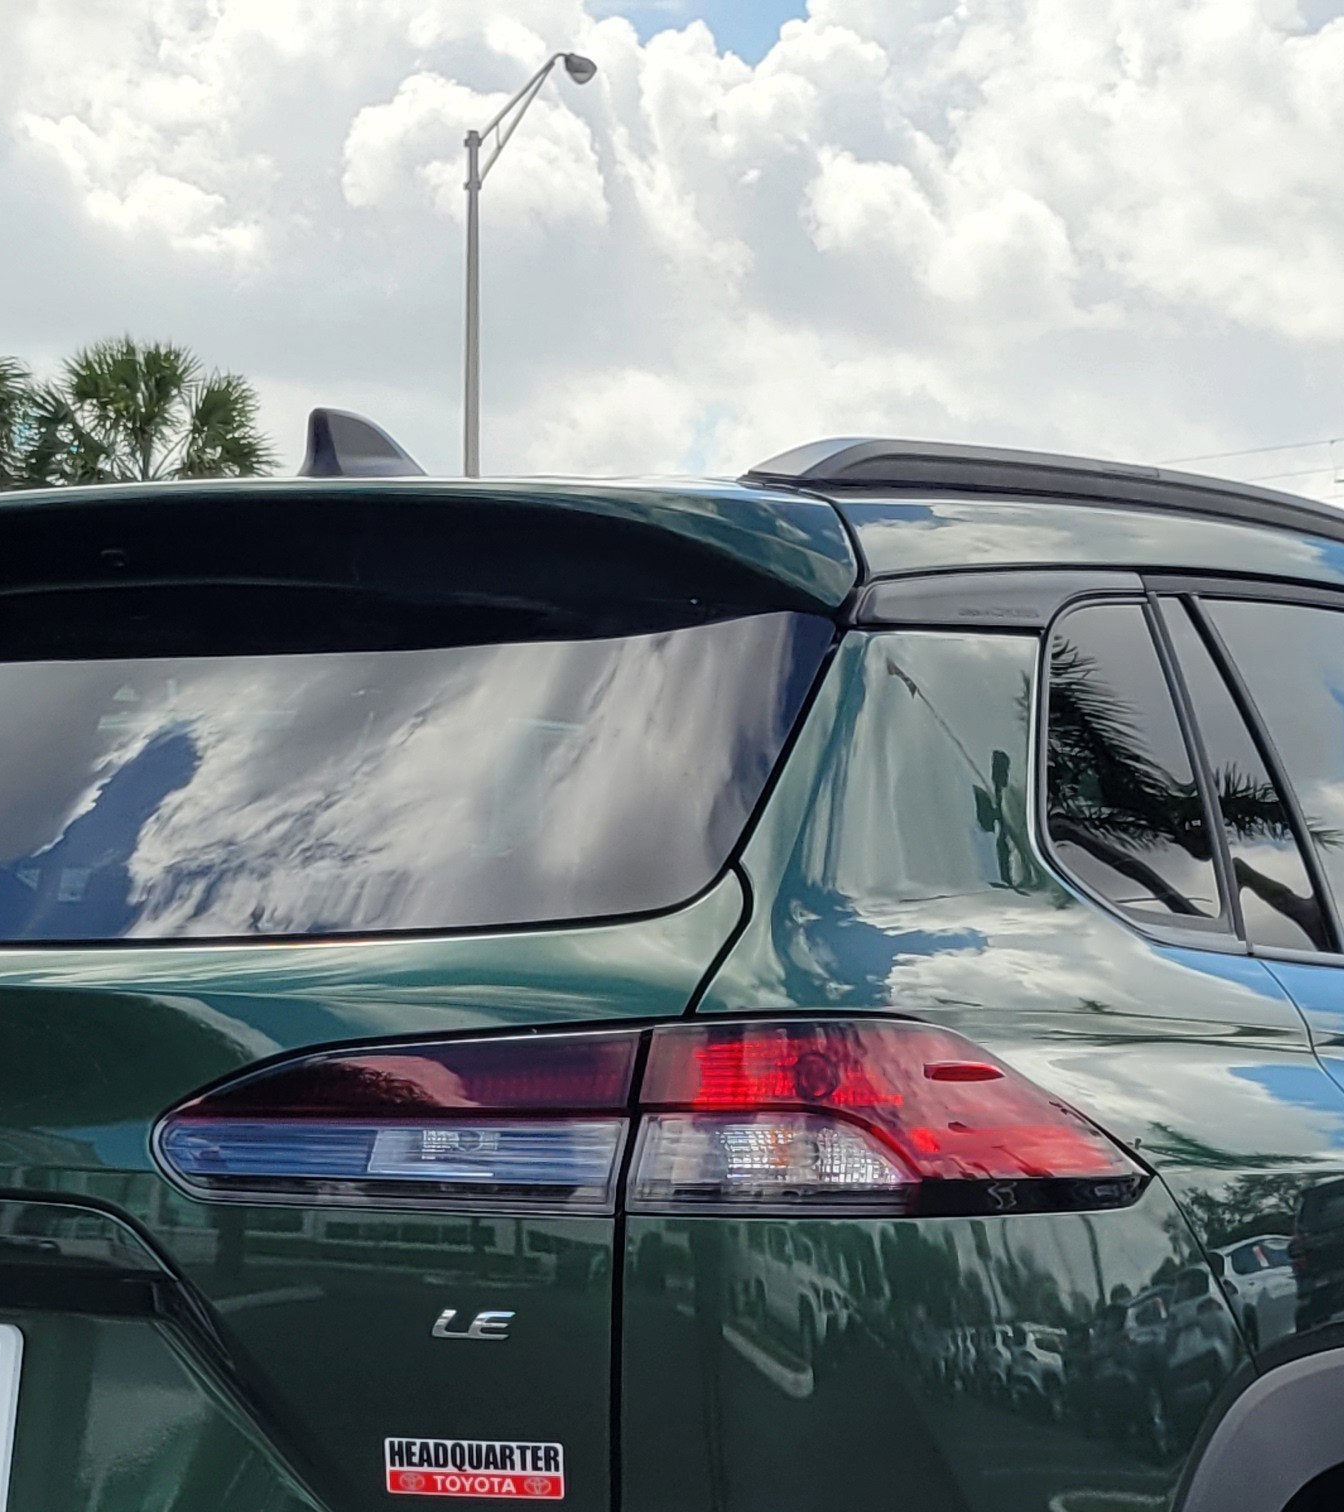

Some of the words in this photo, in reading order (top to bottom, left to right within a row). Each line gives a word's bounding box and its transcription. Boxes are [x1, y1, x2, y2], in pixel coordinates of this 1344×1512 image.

[431, 1309, 516, 1340] LE
[388, 1440, 560, 1472] HEADQUARTER
[433, 1475, 517, 1493] TOYOTA
